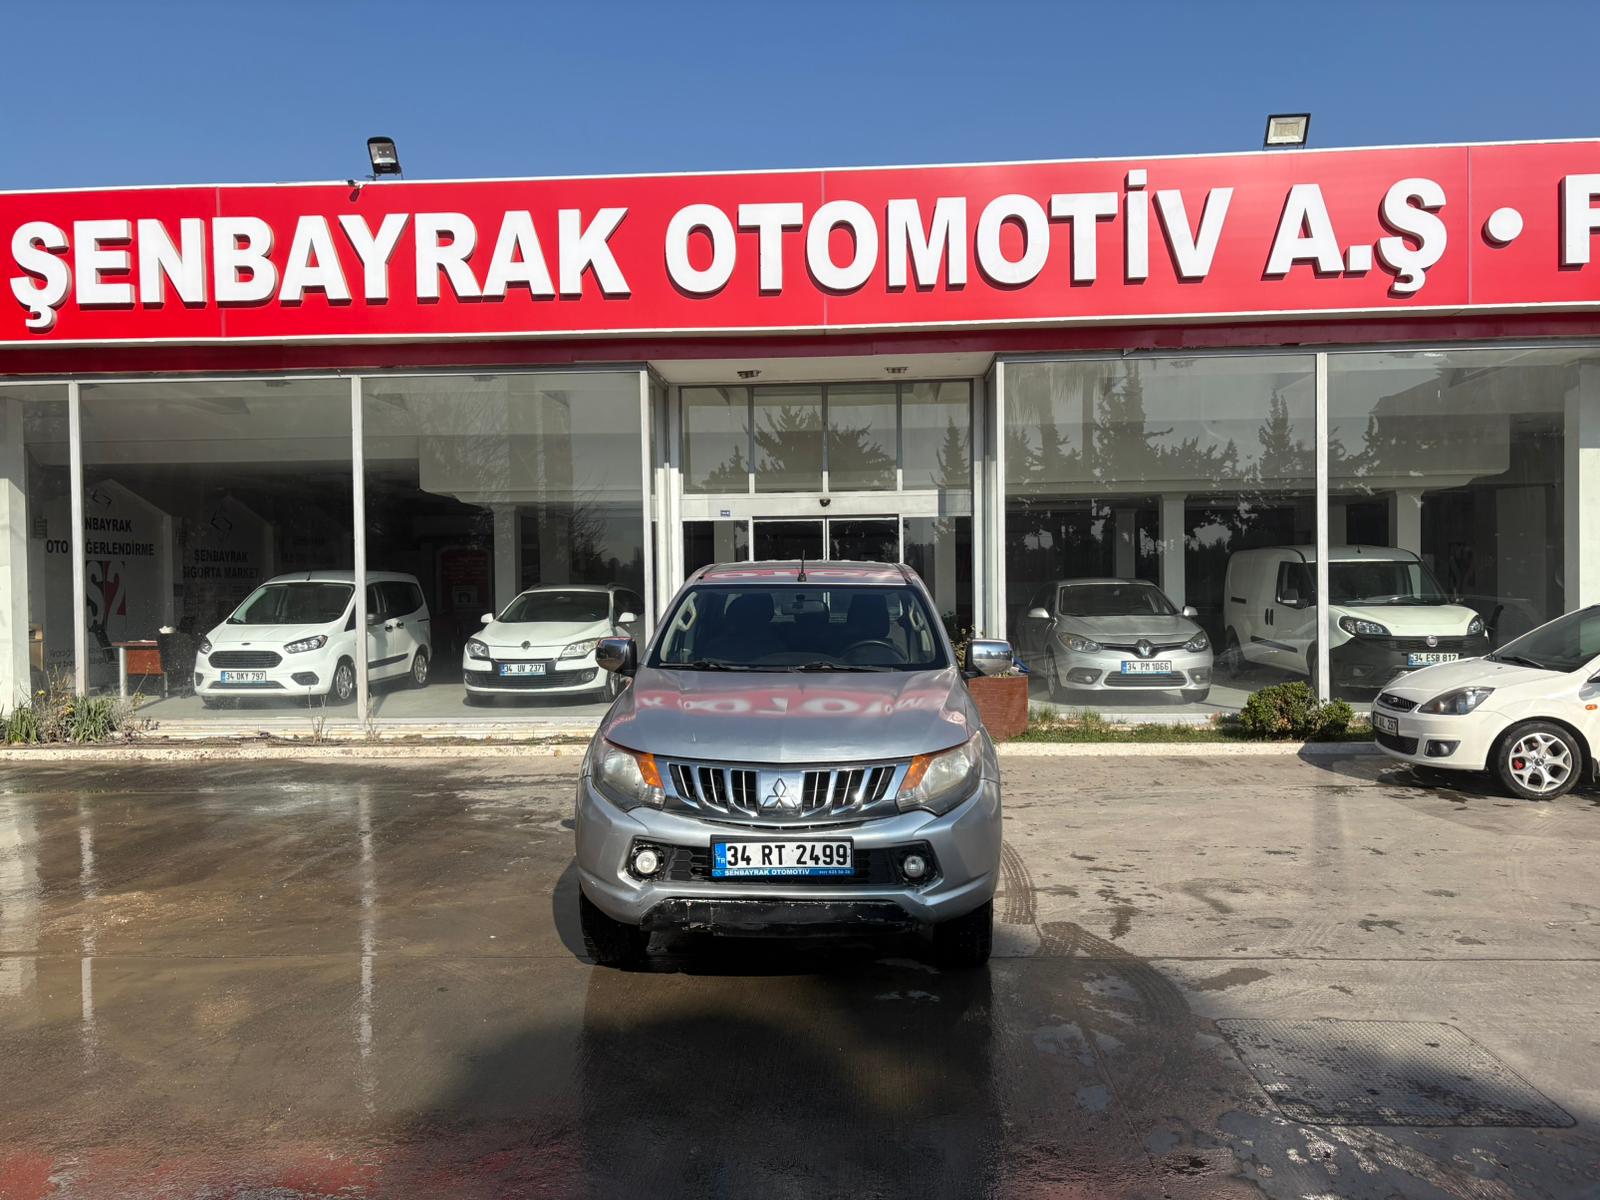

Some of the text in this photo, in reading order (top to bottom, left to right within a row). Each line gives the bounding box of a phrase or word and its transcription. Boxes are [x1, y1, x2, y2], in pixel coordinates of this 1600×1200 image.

[9, 206, 631, 329] ŞENBAYRAK
[665, 169, 1235, 295] OTOMOTİV
[1266, 178, 1448, 292] A.Ş
[85, 517, 132, 532] NBAYRAK
[46, 539, 154, 556] OTO ĞERLENDİRME
[504, 664, 513, 672] 34
[529, 664, 545, 672] 2371
[1127, 662, 1136, 671] 34
[1152, 662, 1169, 671] 1066
[226, 672, 234, 680] 34
[251, 672, 264, 681] 797
[726, 843, 848, 867] 34 RT 2499
